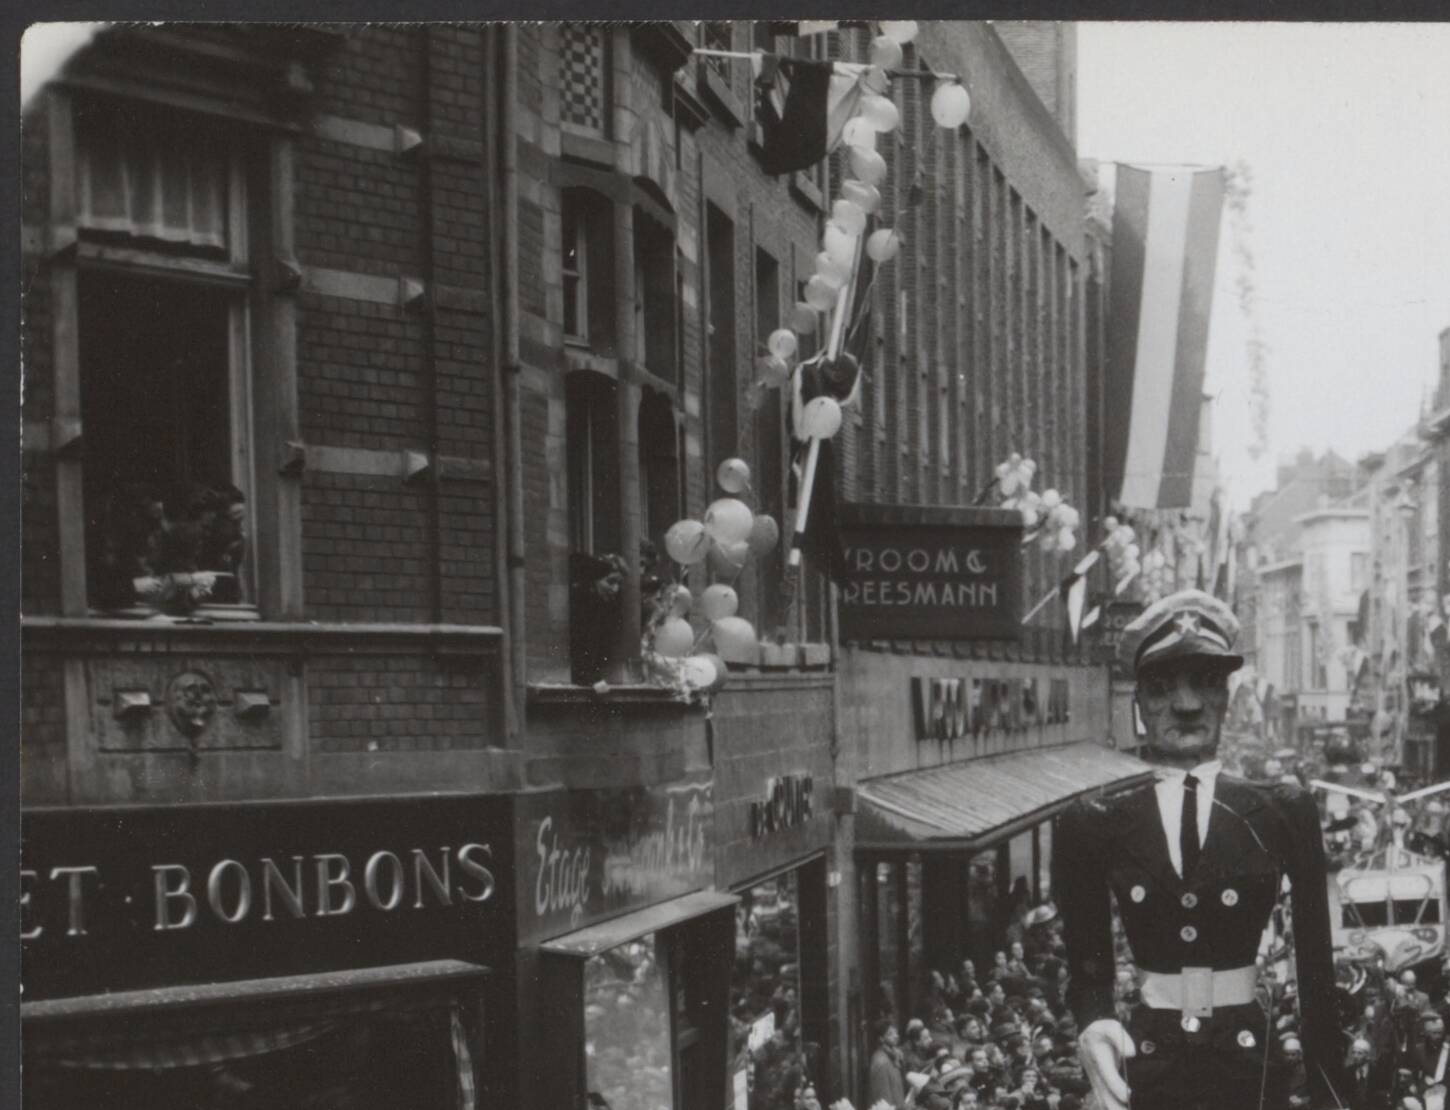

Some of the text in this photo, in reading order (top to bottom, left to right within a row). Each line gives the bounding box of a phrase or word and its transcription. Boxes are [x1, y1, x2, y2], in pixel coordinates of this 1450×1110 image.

[843, 547, 960, 573] ROOM
[839, 580, 998, 607] REESMANN
[151, 843, 496, 932] BONBONS
[535, 815, 592, 929] Etage
